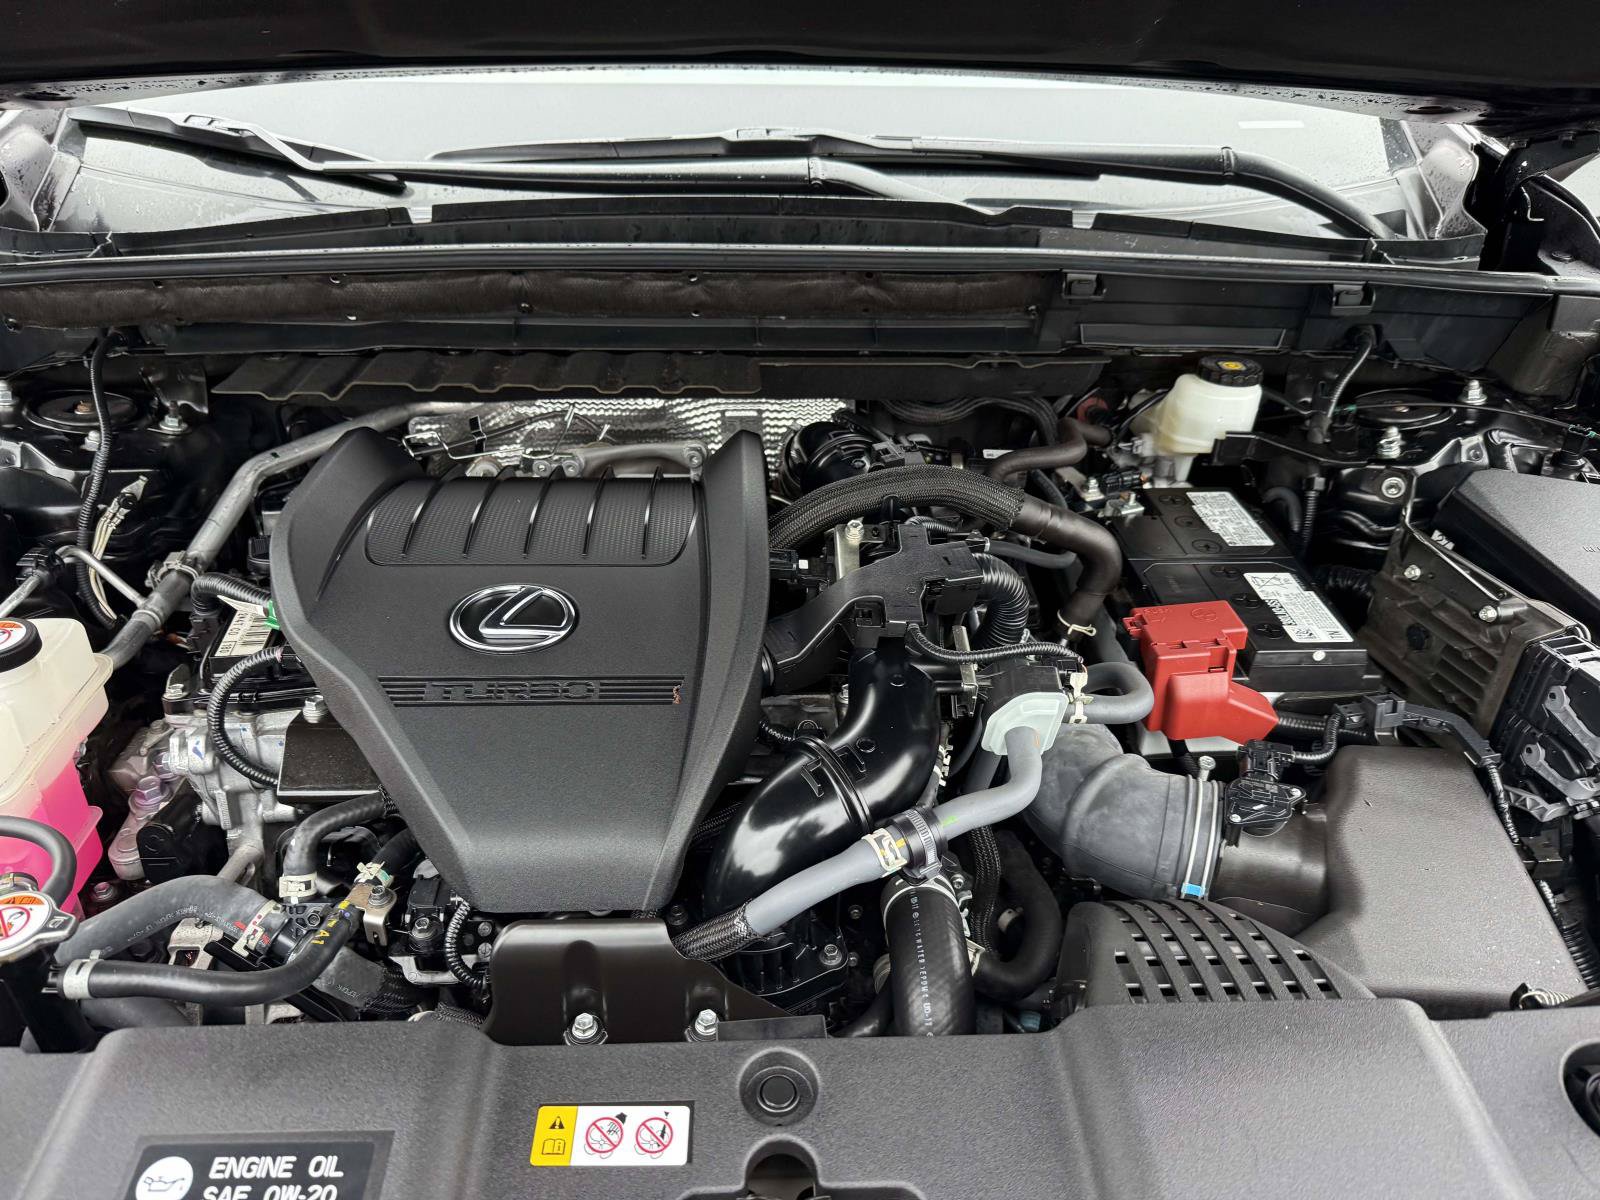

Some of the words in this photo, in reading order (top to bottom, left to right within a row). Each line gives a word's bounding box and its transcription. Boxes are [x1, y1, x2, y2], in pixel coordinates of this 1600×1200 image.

[430, 681, 595, 700] TURBO
[208, 1155, 297, 1179] ENGINE
[308, 1155, 344, 1178] OIL
